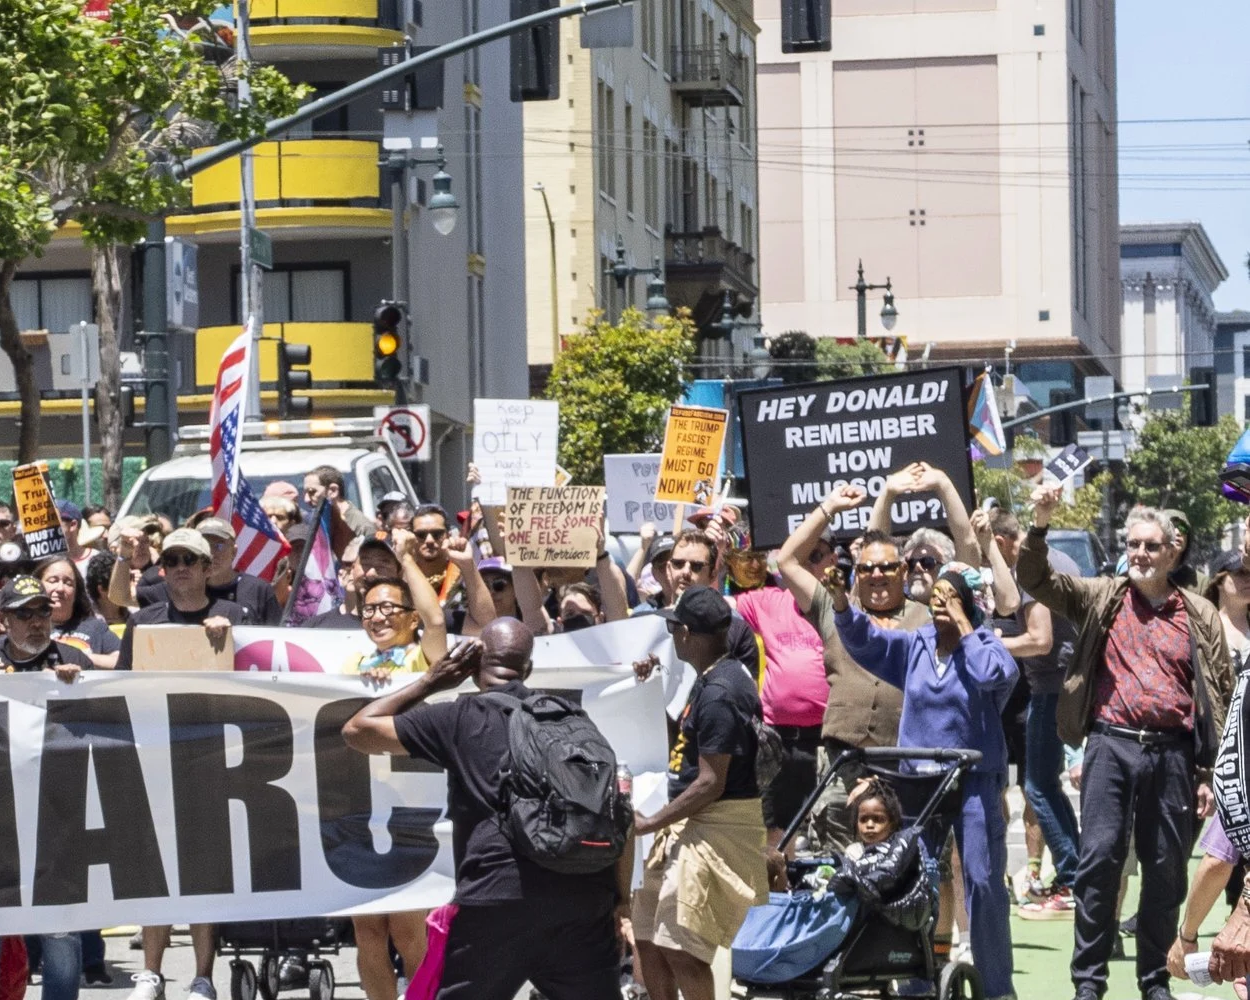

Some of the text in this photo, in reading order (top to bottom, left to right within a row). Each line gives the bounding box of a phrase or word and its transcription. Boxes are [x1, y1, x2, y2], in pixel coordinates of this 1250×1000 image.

[756, 380, 949, 422] HEY DONALD!
[673, 419, 720, 432] THE TRUMP
[784, 413, 937, 449] REMEMBER
[482, 431, 542, 454] OILY
[677, 432, 712, 445] FASCIST
[676, 446, 707, 458] REGIME
[664, 458, 714, 476] MUST GO
[827, 446, 893, 474] HOW
[31, 478, 43, 486] Th
[658, 478, 692, 495] NOW!
[511, 487, 534, 500] THE
[539, 486, 600, 500] FUNCTION
[510, 501, 601, 515] OF FREEDOM IS
[508, 515, 597, 530] TO FREE SOME
[25, 528, 55, 544] MUST
[508, 529, 571, 545] ONE ELSE.
[544, 548, 591, 561] Morrison
